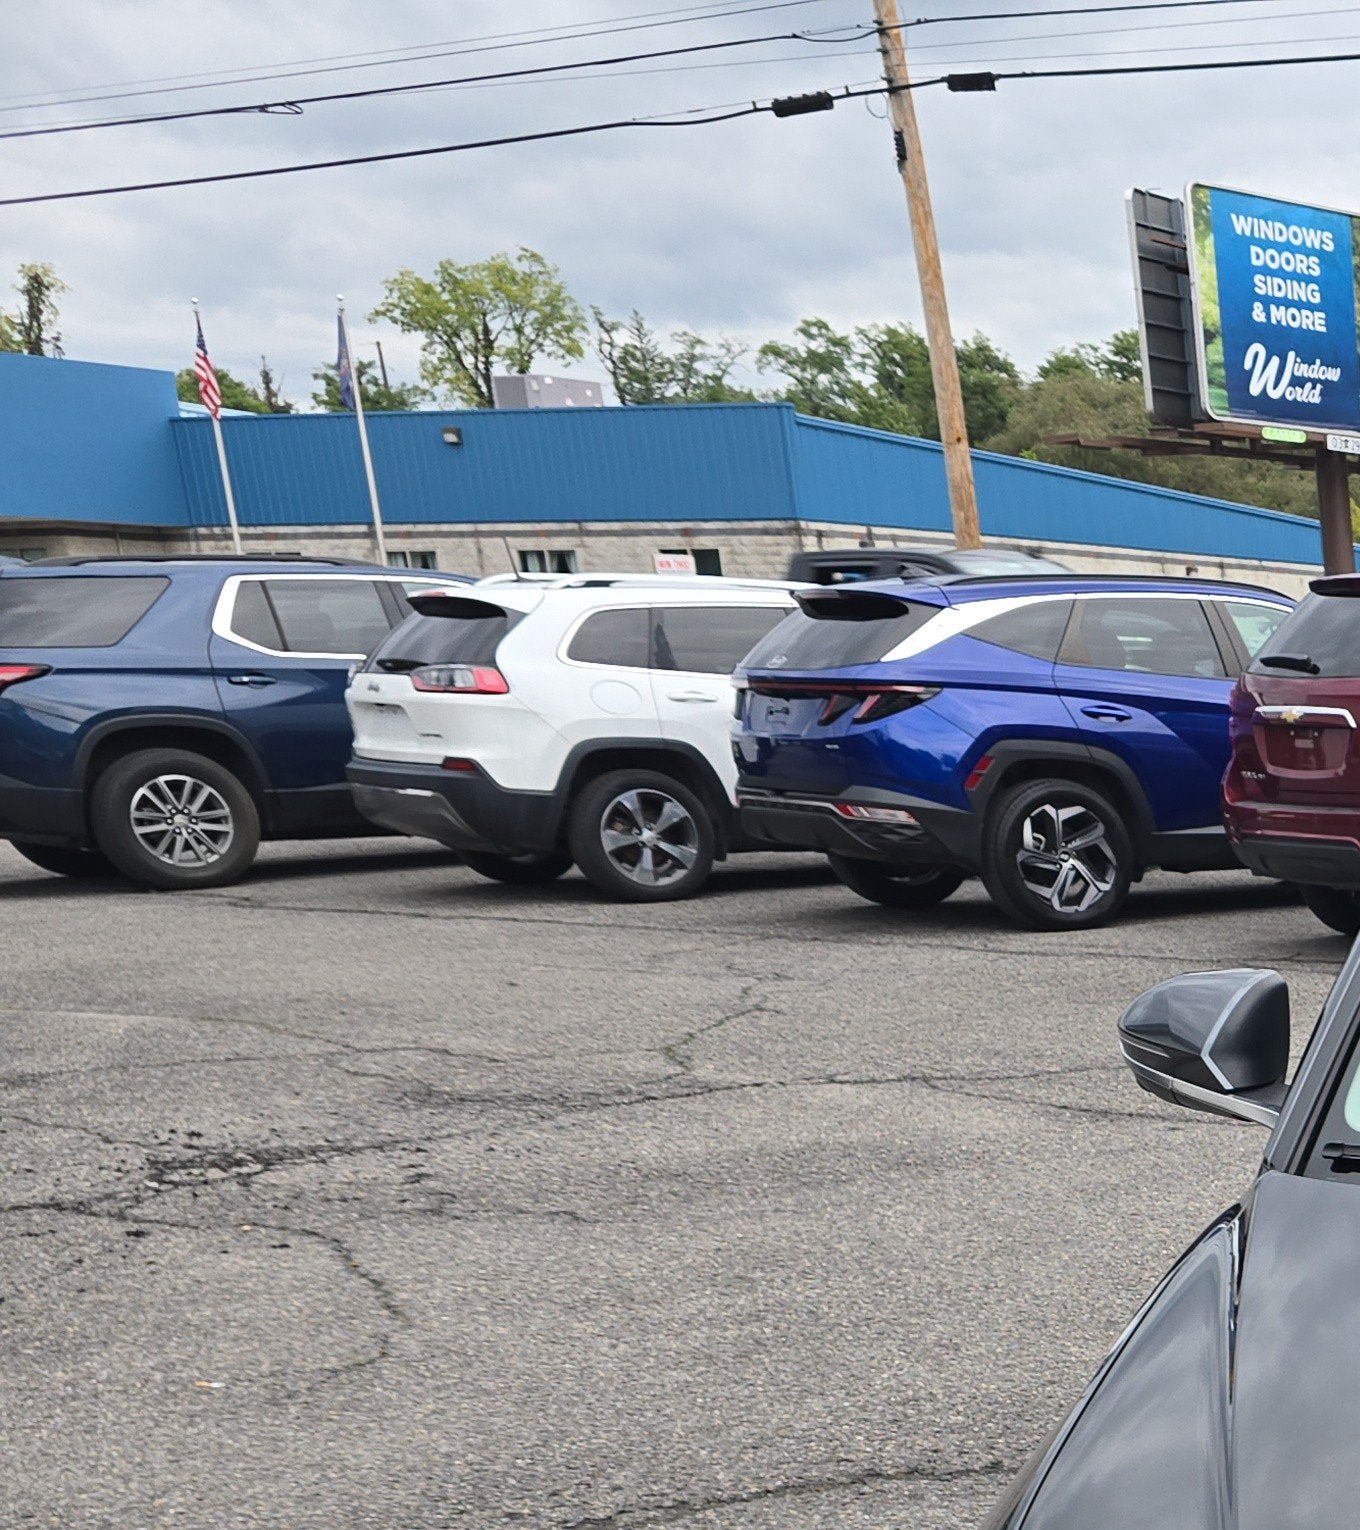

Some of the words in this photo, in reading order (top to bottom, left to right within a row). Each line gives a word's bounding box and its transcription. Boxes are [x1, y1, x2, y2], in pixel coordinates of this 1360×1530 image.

[1230, 213, 1335, 252] WINDOWS
[1250, 245, 1321, 277] DOORS
[1253, 274, 1321, 304] SIDING
[1252, 301, 1267, 323] &
[1269, 304, 1327, 333] MORE
[1243, 342, 1341, 400] Window
